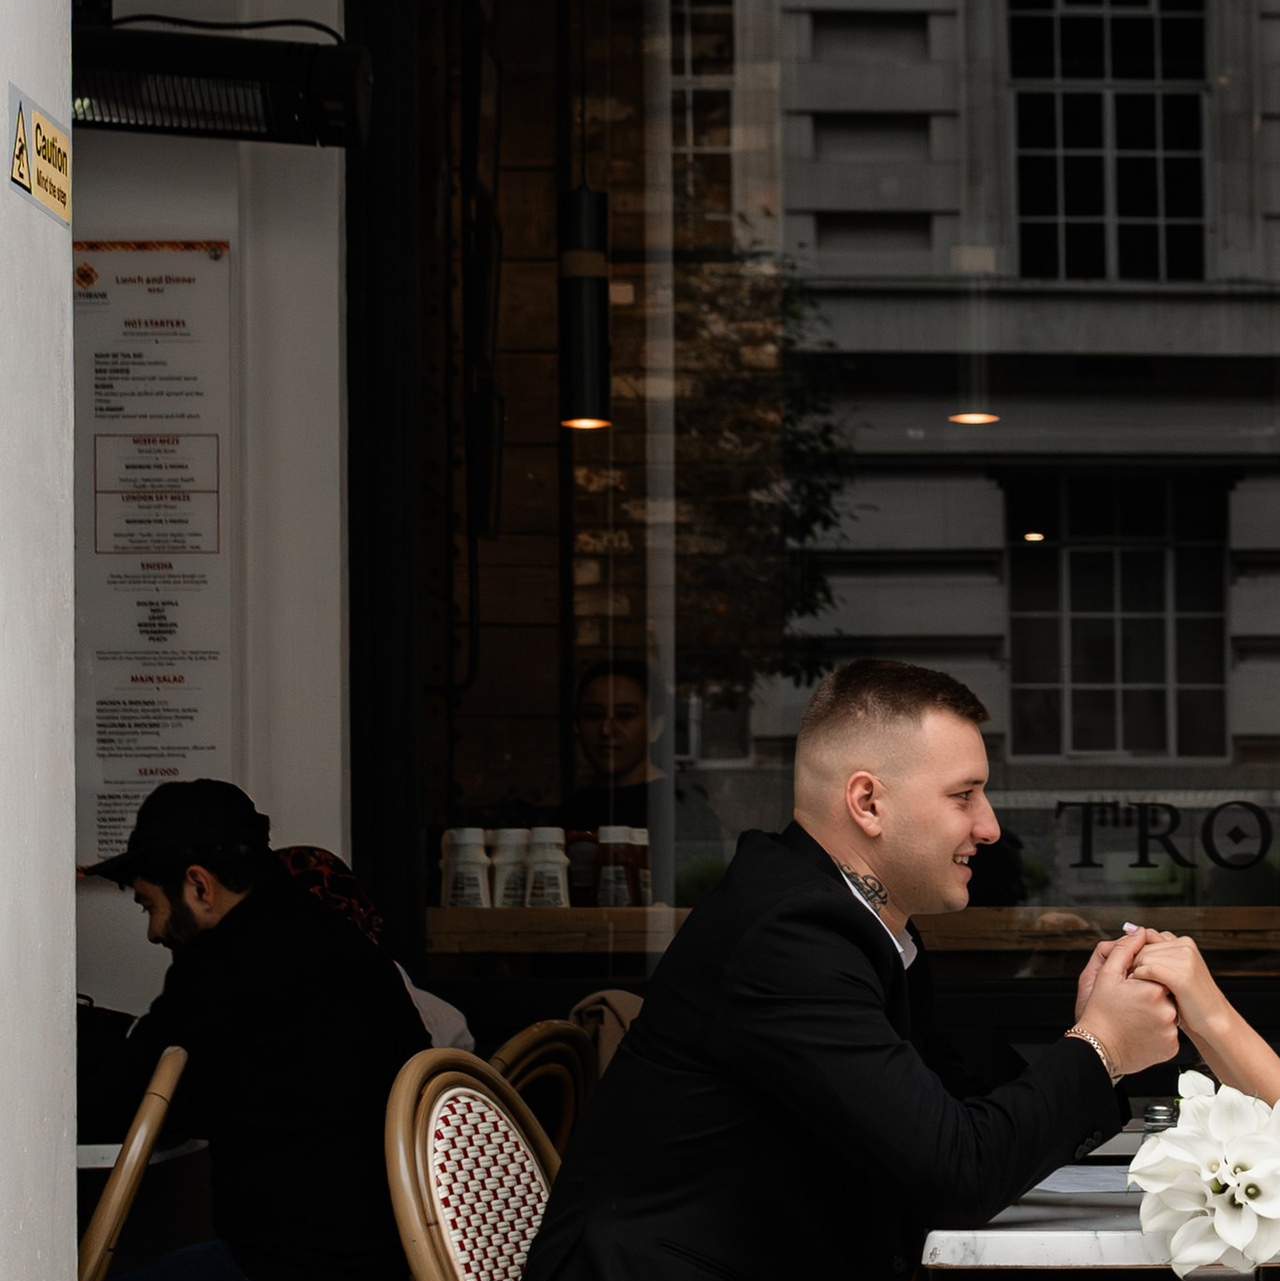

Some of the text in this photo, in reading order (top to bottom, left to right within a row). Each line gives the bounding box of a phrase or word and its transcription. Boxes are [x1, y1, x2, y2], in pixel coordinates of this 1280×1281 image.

[35, 122, 68, 177] Caution
[36, 167, 67, 209] Mind the step
[115, 274, 196, 286] Lunch and Dinner
[130, 675, 185, 684] MAIN SALAD
[138, 767, 180, 776] SEAFOOD
